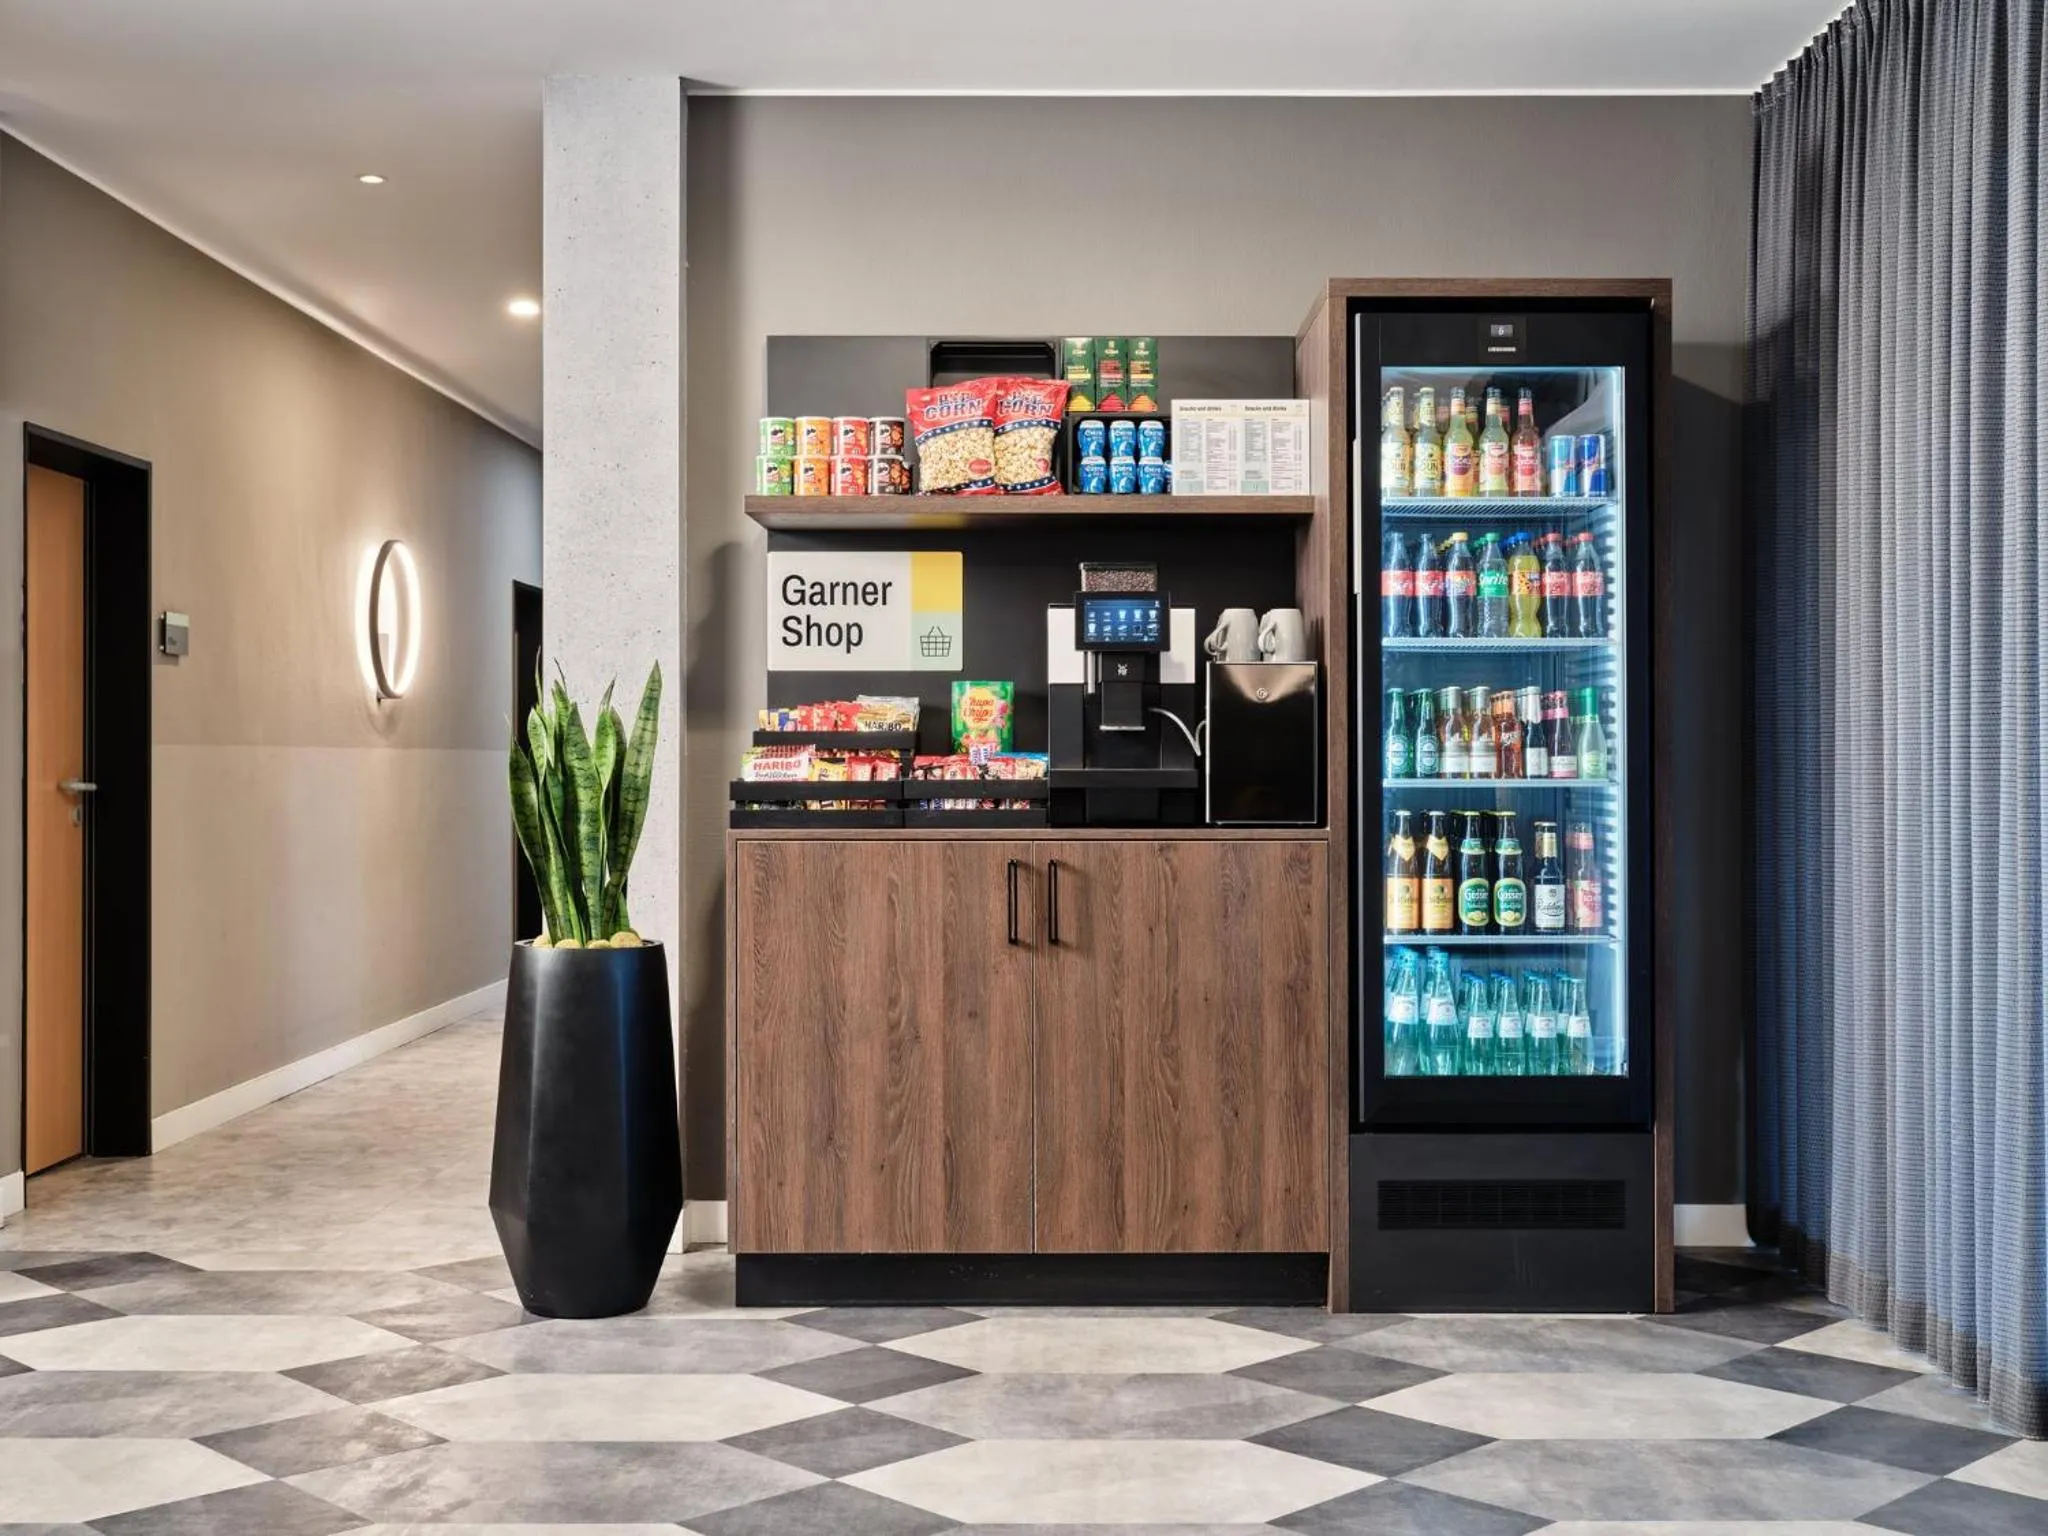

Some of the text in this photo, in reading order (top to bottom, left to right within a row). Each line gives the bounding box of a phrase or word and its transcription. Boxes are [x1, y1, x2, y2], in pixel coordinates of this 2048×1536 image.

[782, 574, 893, 606] Garner
[1478, 573, 1509, 587] Sprite
[782, 614, 863, 654] Shop
[753, 759, 801, 771] HARIBO
